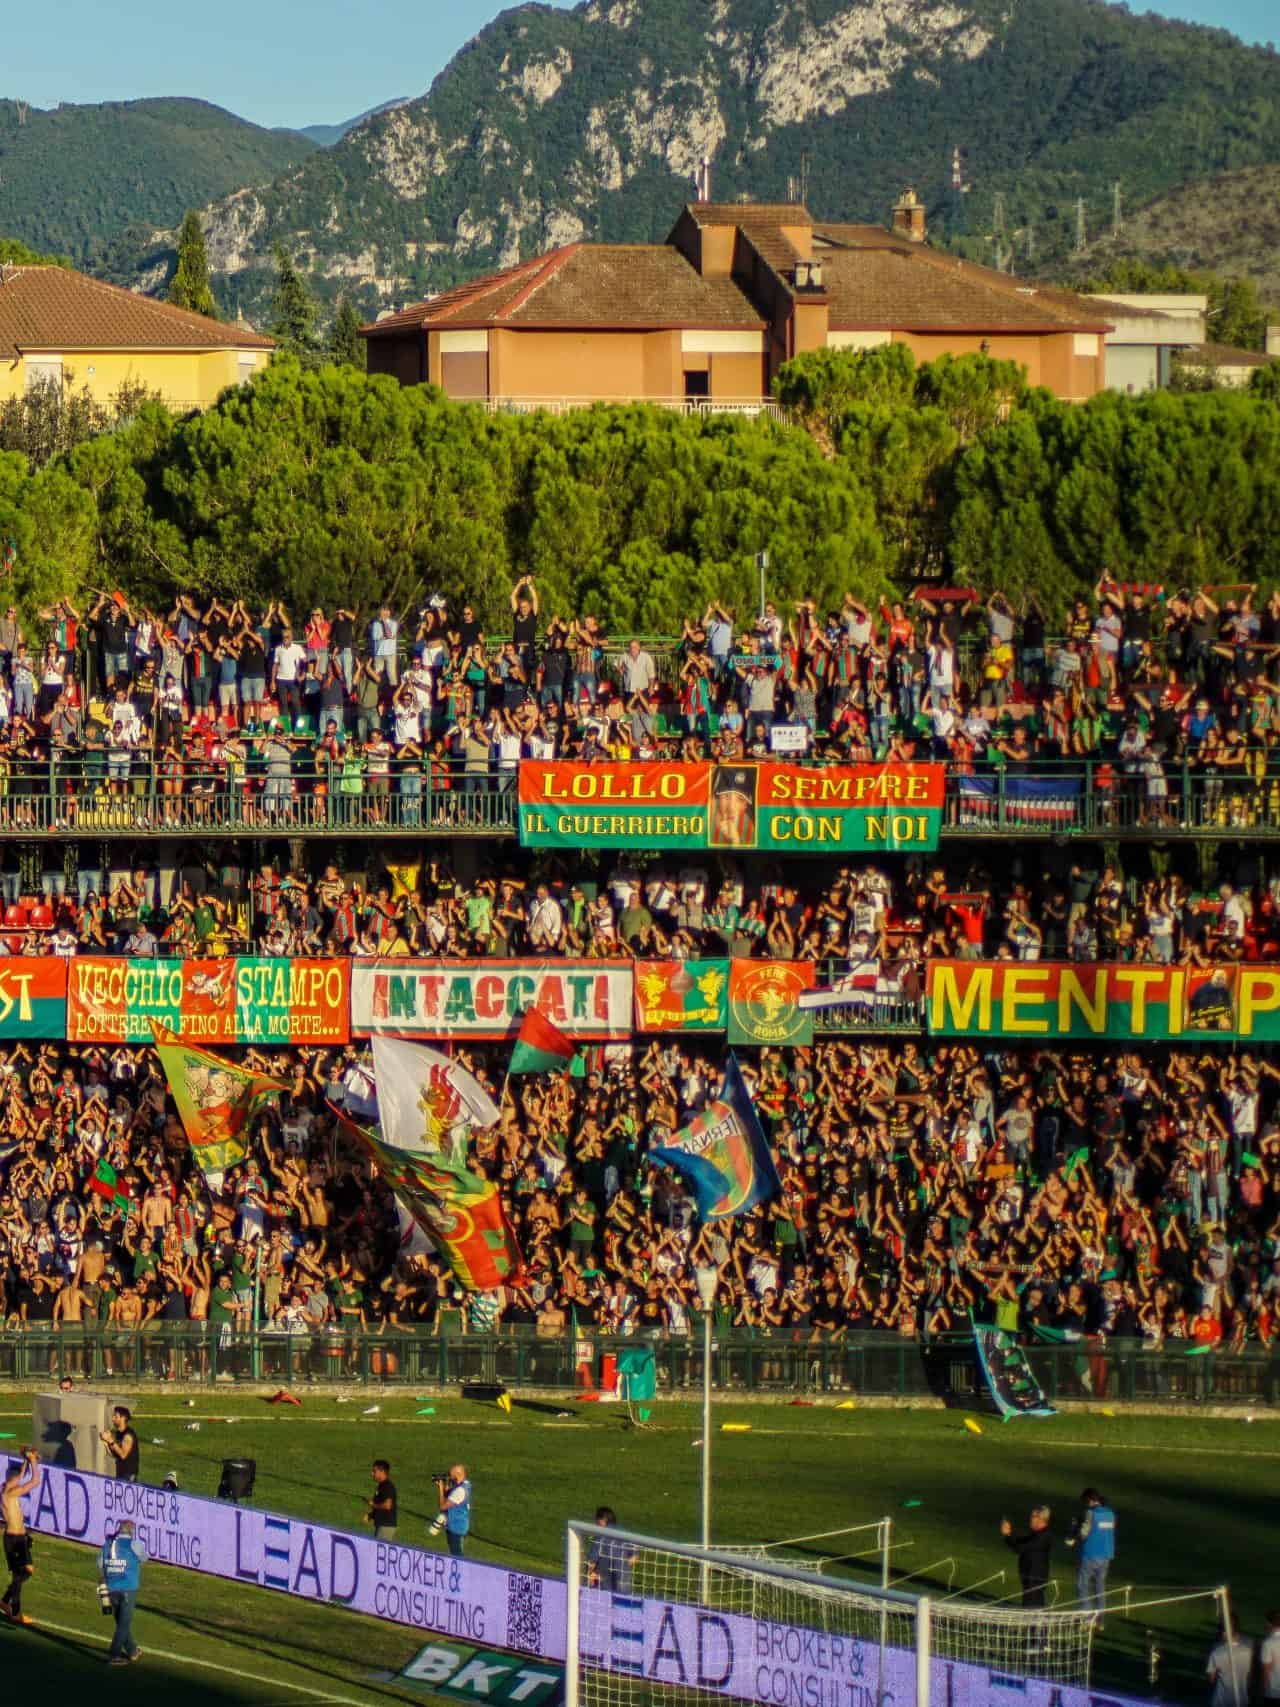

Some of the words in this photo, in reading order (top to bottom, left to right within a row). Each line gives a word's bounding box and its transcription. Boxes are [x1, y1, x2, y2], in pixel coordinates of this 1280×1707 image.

[542, 771, 687, 800] LOLLO
[771, 773, 929, 801] SEMPRE
[526, 814, 550, 834] IL
[558, 814, 703, 836] GUERRIERO
[770, 815, 841, 842] CON
[865, 814, 928, 842] NOI
[76, 964, 183, 1007] VECCHIO
[238, 967, 343, 1007] STAMPO
[373, 974, 609, 1022] INTACCATI
[931, 966, 1184, 1035] MENTI
[77, 1012, 174, 1035] LOTTEREO
[180, 1015, 218, 1035] FINO
[224, 1015, 265, 1035] ALLA
[104, 1480, 166, 1523] BROKER
[168, 1494, 180, 1525] &
[104, 1517, 201, 1568] CSULTING
[234, 1511, 359, 1603] LEAD
[376, 1543, 445, 1593] BROKER
[449, 1559, 461, 1593] &
[374, 1582, 485, 1639] CONSULTING
[756, 1621, 845, 1673] BROKER
[850, 1640, 864, 1677] &
[402, 1646, 559, 1702] BKT
